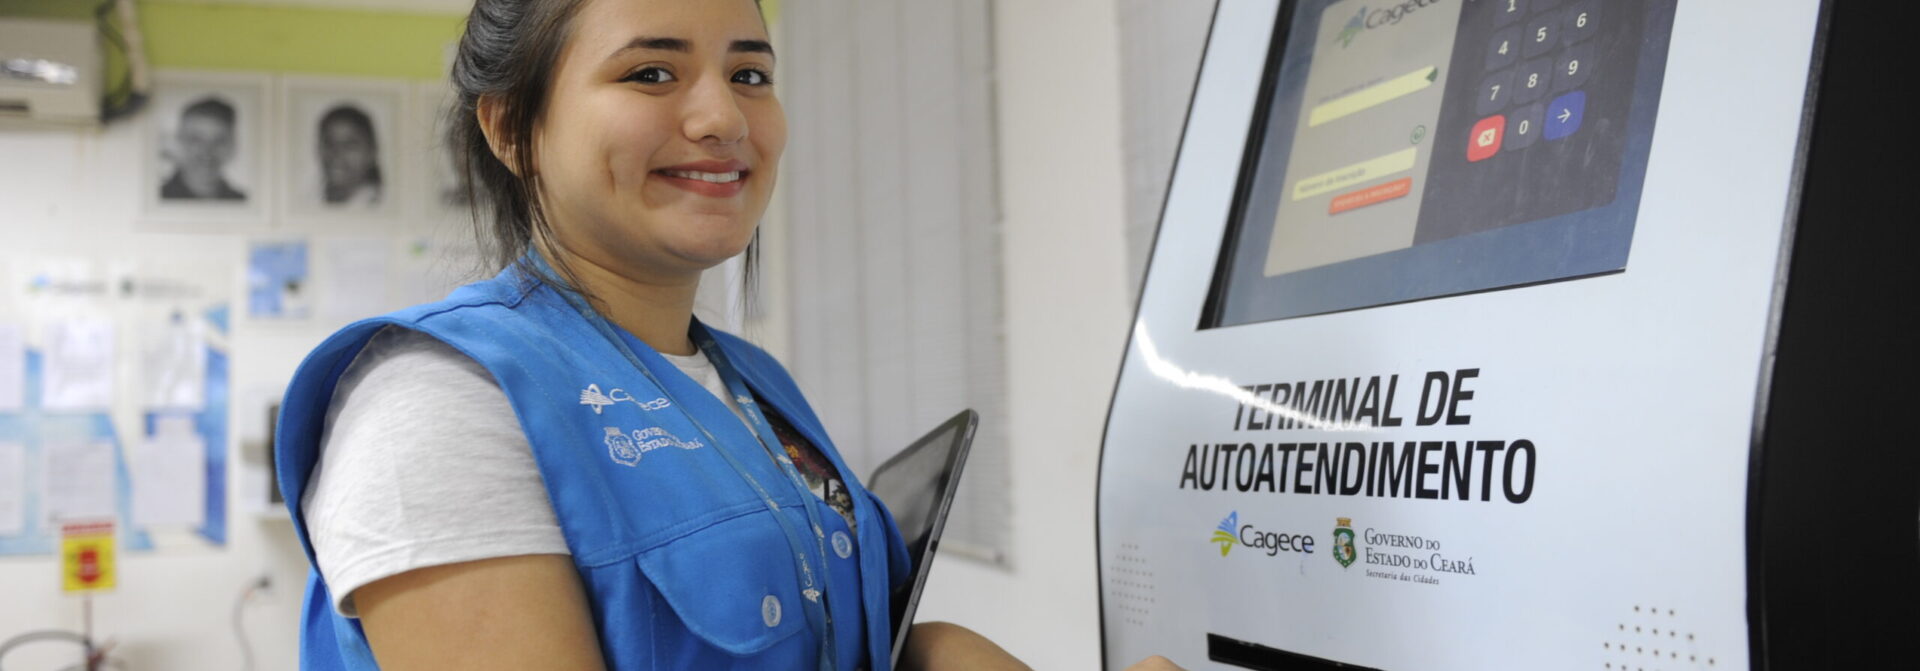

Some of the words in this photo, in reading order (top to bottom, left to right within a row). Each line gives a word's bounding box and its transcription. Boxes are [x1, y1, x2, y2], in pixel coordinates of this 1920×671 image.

[1506, 0, 1517, 13] 1
[1498, 40, 1509, 55] 4
[1536, 26, 1548, 42] 5
[1576, 12, 1588, 28] 6
[1490, 85, 1501, 101] 7
[1527, 73, 1538, 88] 8
[1567, 60, 1579, 75] 9
[1519, 120, 1529, 135] 0
[1233, 374, 1403, 432] TERMINAL
[1415, 367, 1481, 427] DE
[1179, 438, 1537, 505] AUTOATENDIMENTO
[1239, 524, 1315, 557] Cagece
[1365, 569, 1398, 581] Secretaria
[1400, 572, 1412, 582] das
[1413, 574, 1440, 585] Cidades
